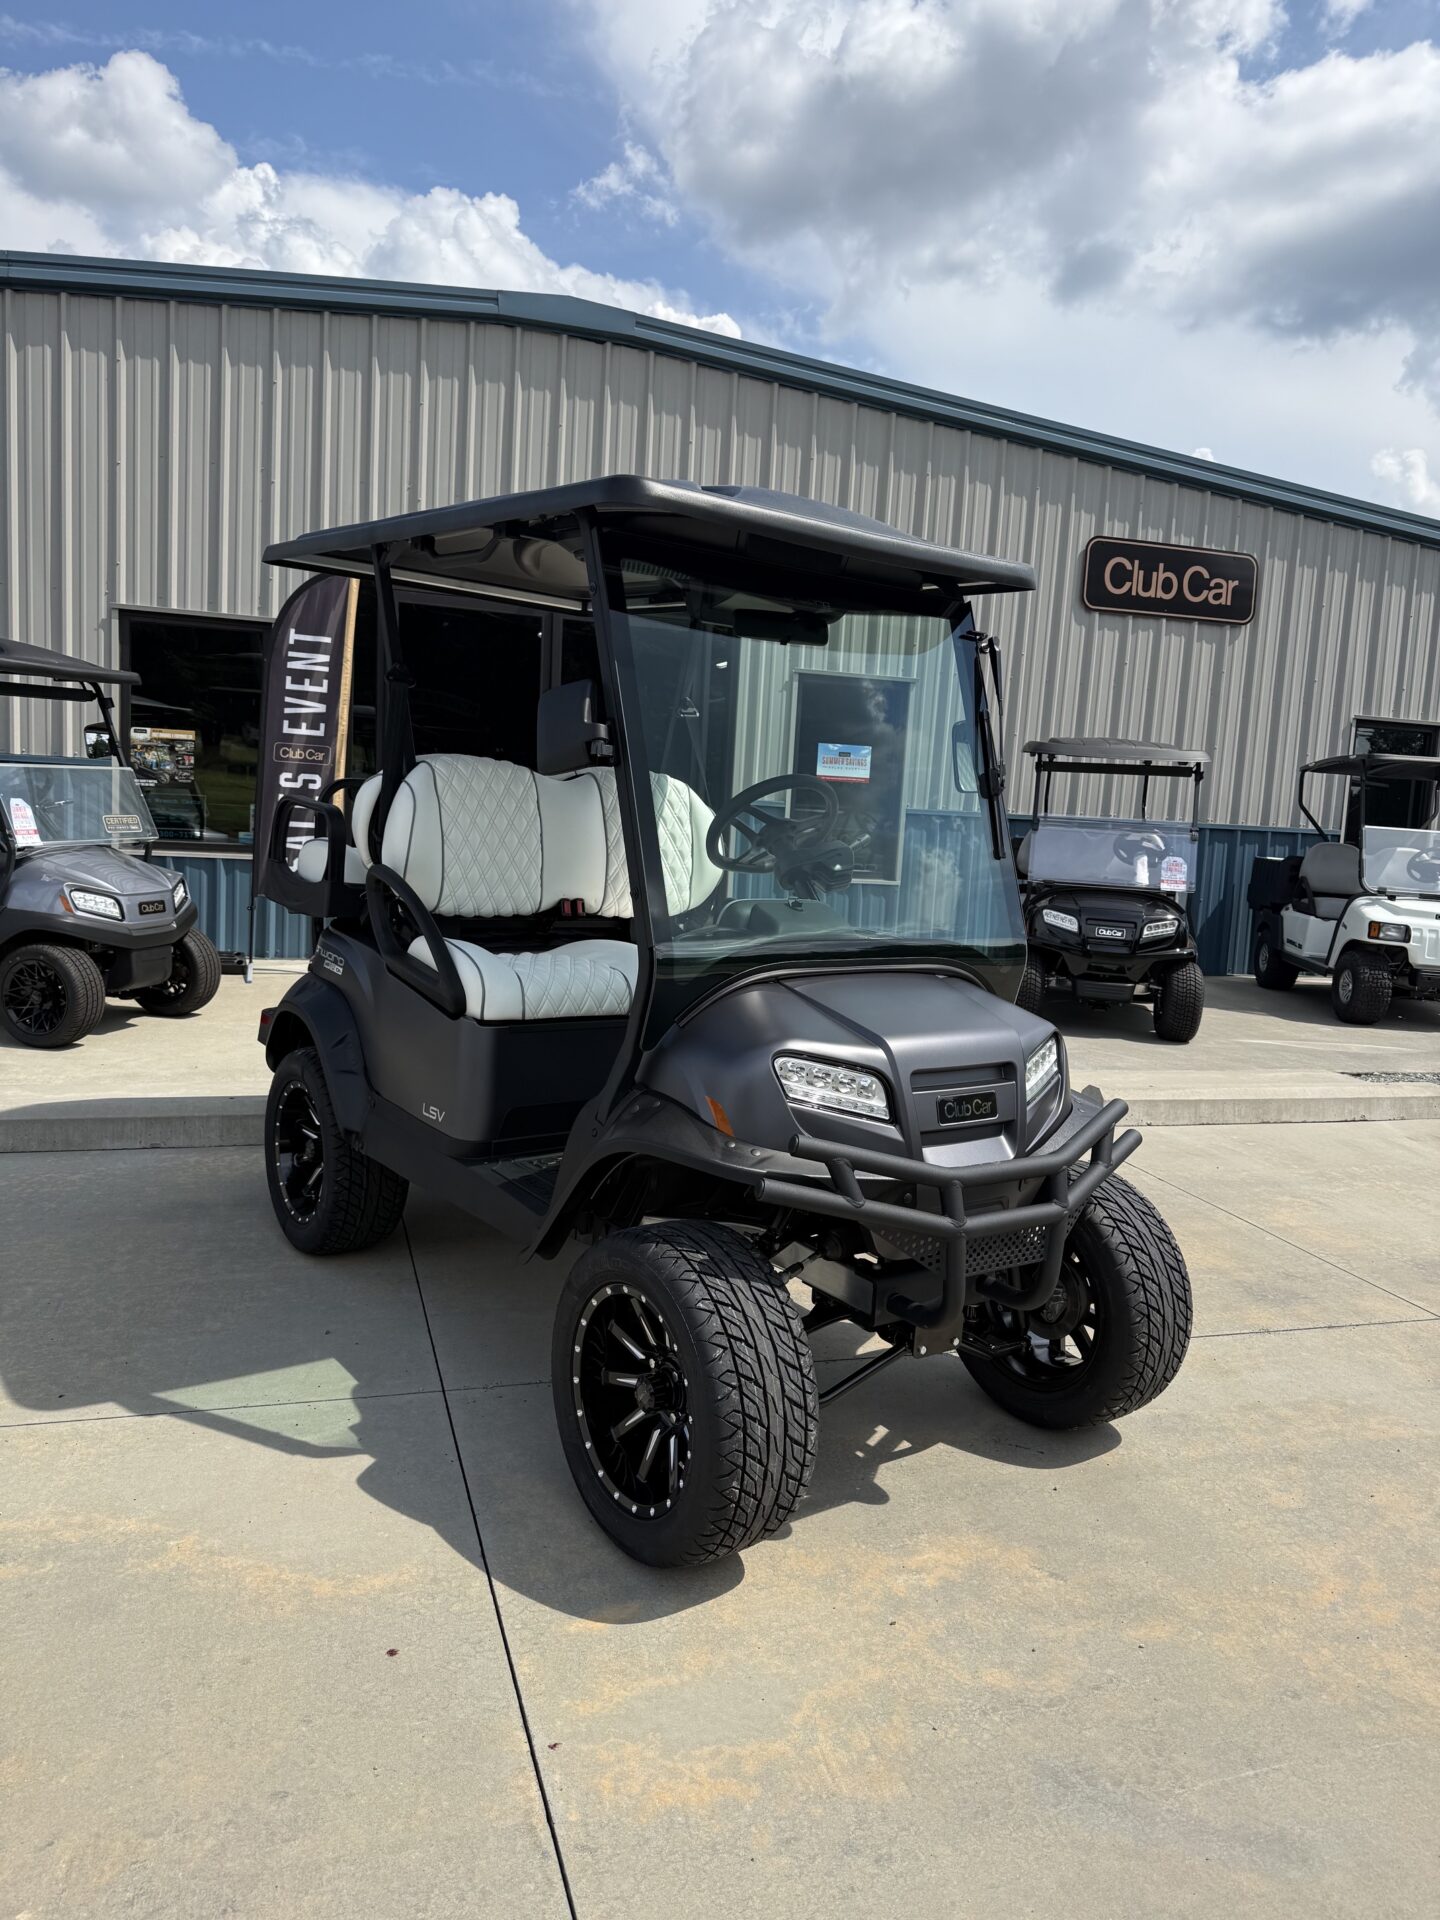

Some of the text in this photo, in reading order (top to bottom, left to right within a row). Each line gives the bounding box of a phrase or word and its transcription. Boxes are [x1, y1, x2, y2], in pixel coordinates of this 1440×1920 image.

[1104, 556, 1239, 606] Club Car
[282, 628, 332, 737] EVENT
[279, 746, 325, 761] Club Car
[105, 817, 138, 825] CERTIFIED
[141, 902, 164, 913] Club Car
[1098, 928, 1123, 937] Club Car
[422, 1102, 446, 1122] LSV
[944, 1098, 992, 1119] Club Car
